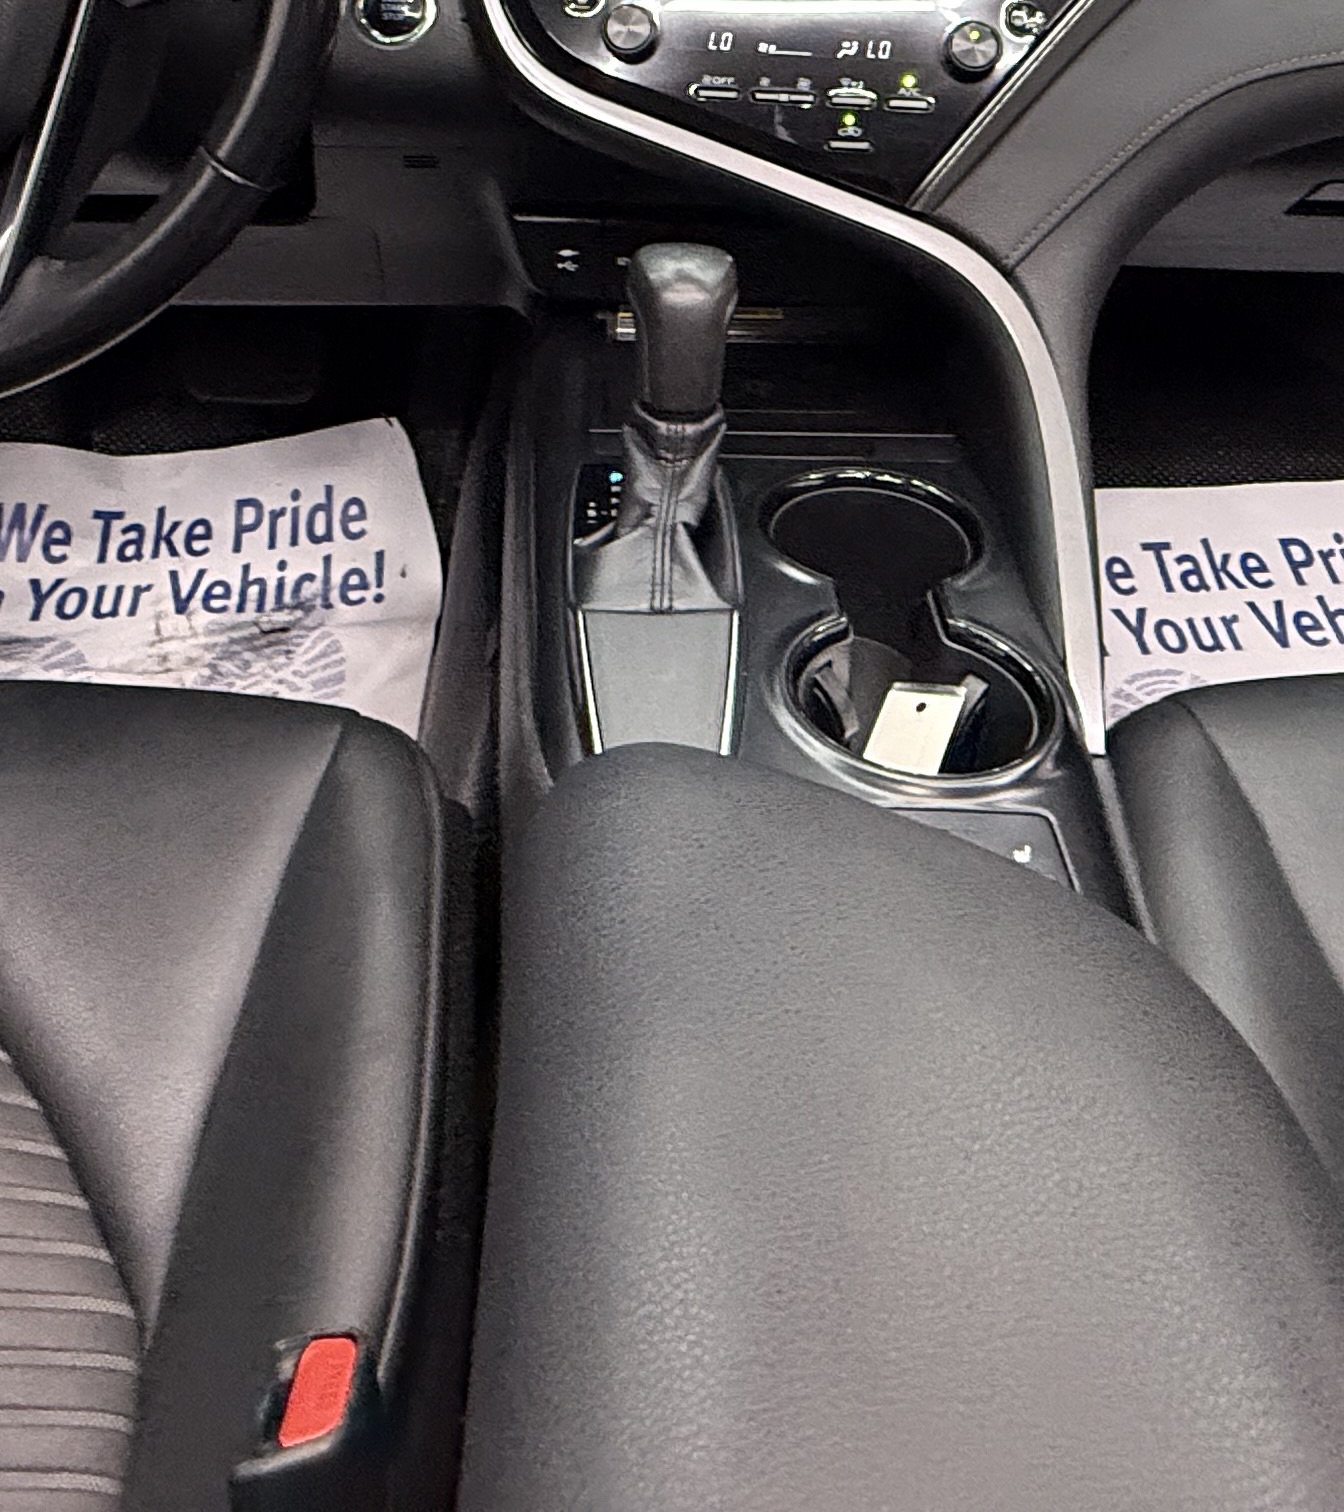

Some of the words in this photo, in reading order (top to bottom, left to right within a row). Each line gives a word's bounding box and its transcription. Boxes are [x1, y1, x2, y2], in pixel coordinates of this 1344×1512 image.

[712, 74, 736, 85] OFF
[91, 505, 214, 564] Take
[231, 485, 368, 555] Pride
[28, 576, 154, 623] Your
[168, 549, 387, 616] Vehicle!
[1105, 554, 1138, 596] e
[1140, 537, 1275, 595] Take
[1111, 607, 1244, 656] Your
